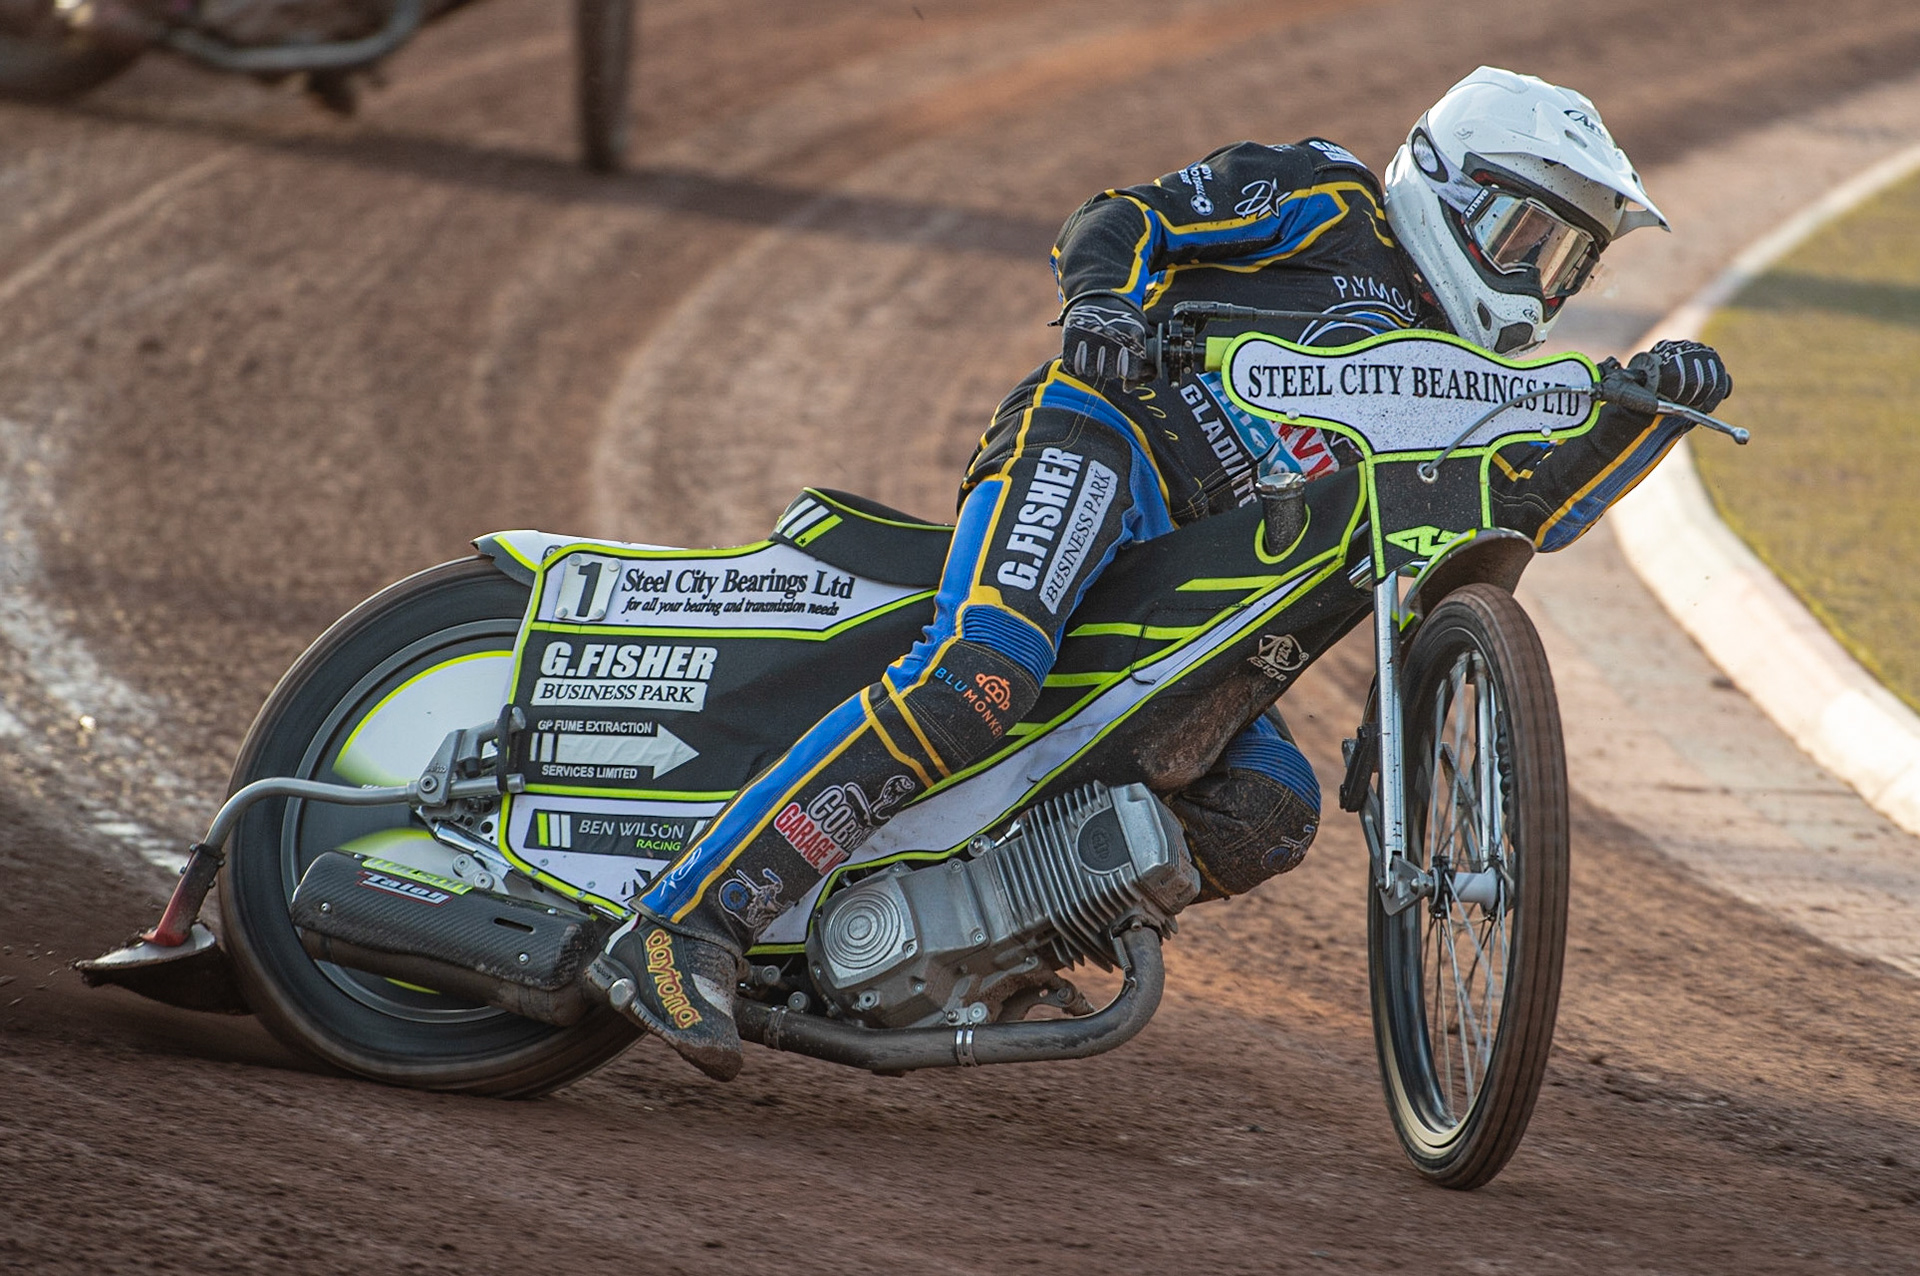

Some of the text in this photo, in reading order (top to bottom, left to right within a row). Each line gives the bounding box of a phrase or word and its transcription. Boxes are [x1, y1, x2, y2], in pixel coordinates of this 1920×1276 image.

[1248, 363, 1580, 416] STEEL CITY BEARINGS LTD
[997, 447, 1084, 591] G.FISHER
[1046, 469, 1112, 602] BUSINESS PARK
[575, 561, 603, 618] 1
[621, 567, 856, 600] Steel City Bearings Ltd
[621, 596, 840, 616] for all your bearing and transmission needs
[540, 641, 719, 680] G.FISHER
[540, 682, 696, 704] BUSINESS PARK
[537, 720, 653, 734] GP FUME EXTRACTION
[541, 765, 638, 780] SERVICES LIMITED
[578, 819, 685, 840] BEN WILSON
[636, 838, 683, 852] RACING
[775, 804, 836, 868] GARAGE
[362, 871, 451, 904] Talon
[645, 928, 703, 1030] daytona
